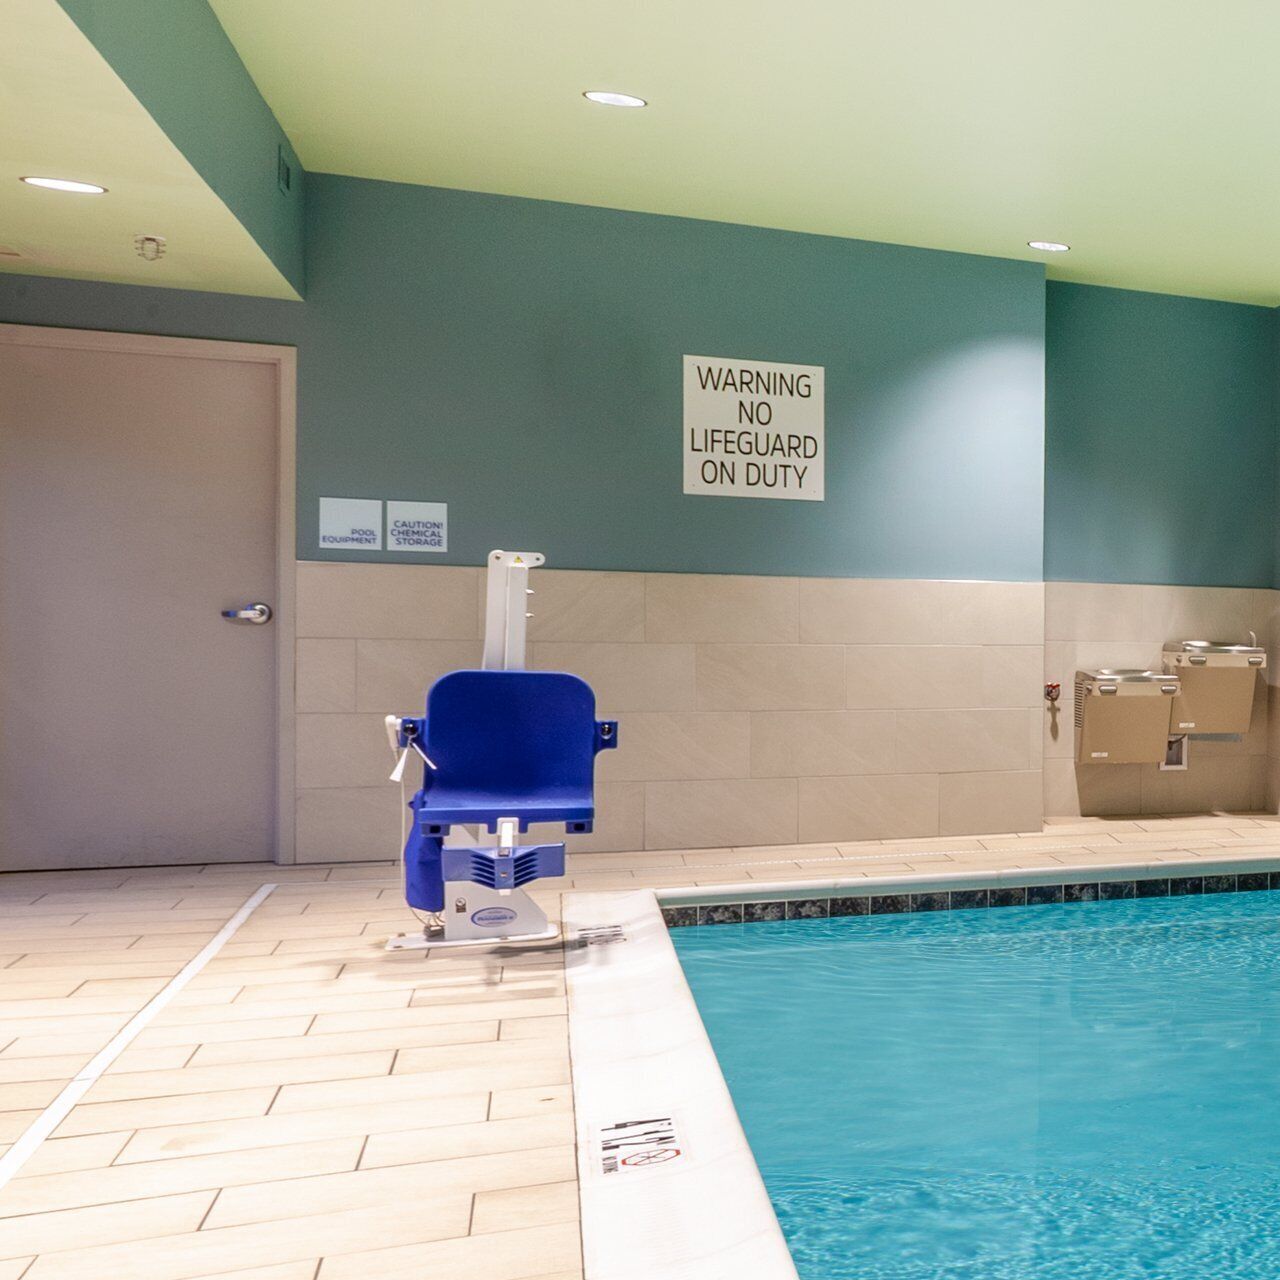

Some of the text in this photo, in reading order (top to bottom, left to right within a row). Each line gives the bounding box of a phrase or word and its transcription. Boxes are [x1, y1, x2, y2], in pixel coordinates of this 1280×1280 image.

[697, 365, 811, 398] WARNING
[739, 400, 772, 426] NO
[691, 428, 818, 459] LIFEGUARD
[701, 459, 808, 488] ON DUTY
[394, 520, 443, 529] CAUTION!
[351, 528, 377, 537] POOL
[391, 528, 443, 538] CHEMICAL
[322, 535, 377, 544] EQUIPMENT
[395, 537, 443, 547] STORAGE
